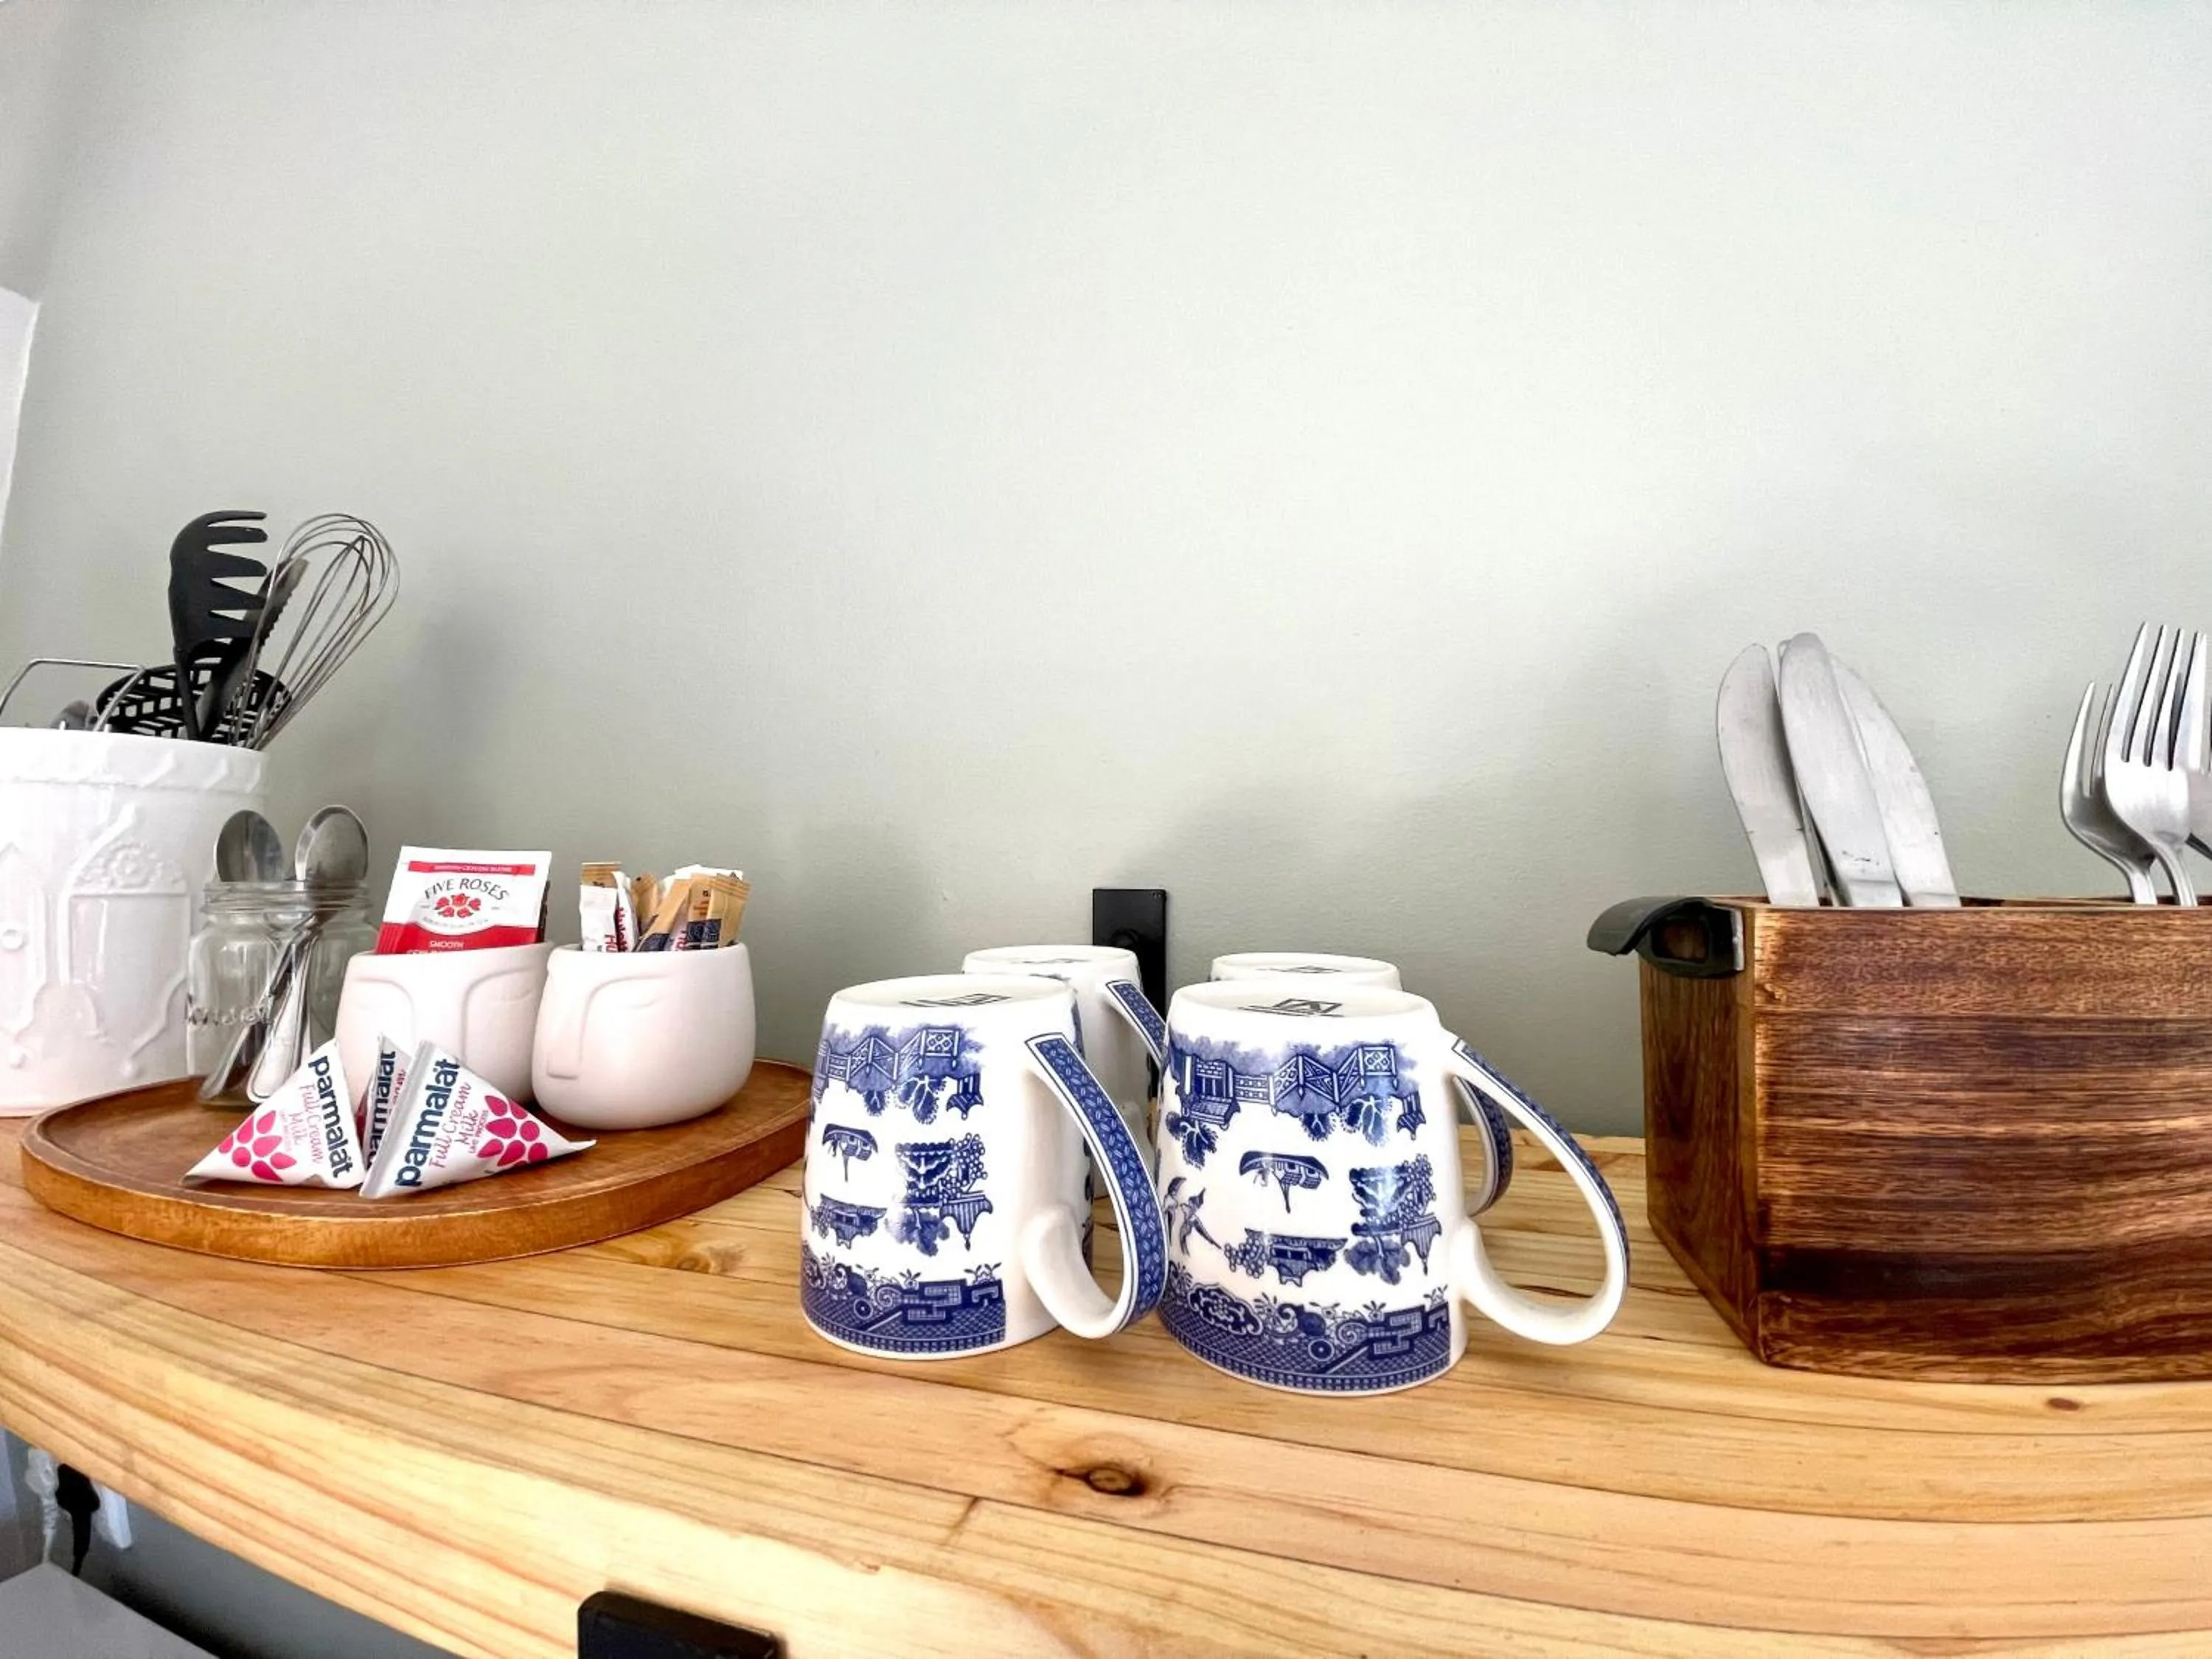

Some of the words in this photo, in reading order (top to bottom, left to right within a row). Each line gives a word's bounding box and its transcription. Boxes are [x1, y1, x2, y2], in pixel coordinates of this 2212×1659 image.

[424, 877, 455, 900] FIVE
[459, 877, 509, 901] ROSES
[299, 1084, 321, 1114] Full
[307, 1055, 354, 1179] parmalat
[394, 1058, 461, 1187] parmalat
[306, 1114, 324, 1165] Cream
[428, 1135, 453, 1169] Full
[442, 1082, 473, 1135] Cream
[453, 1109, 479, 1146] Milk
